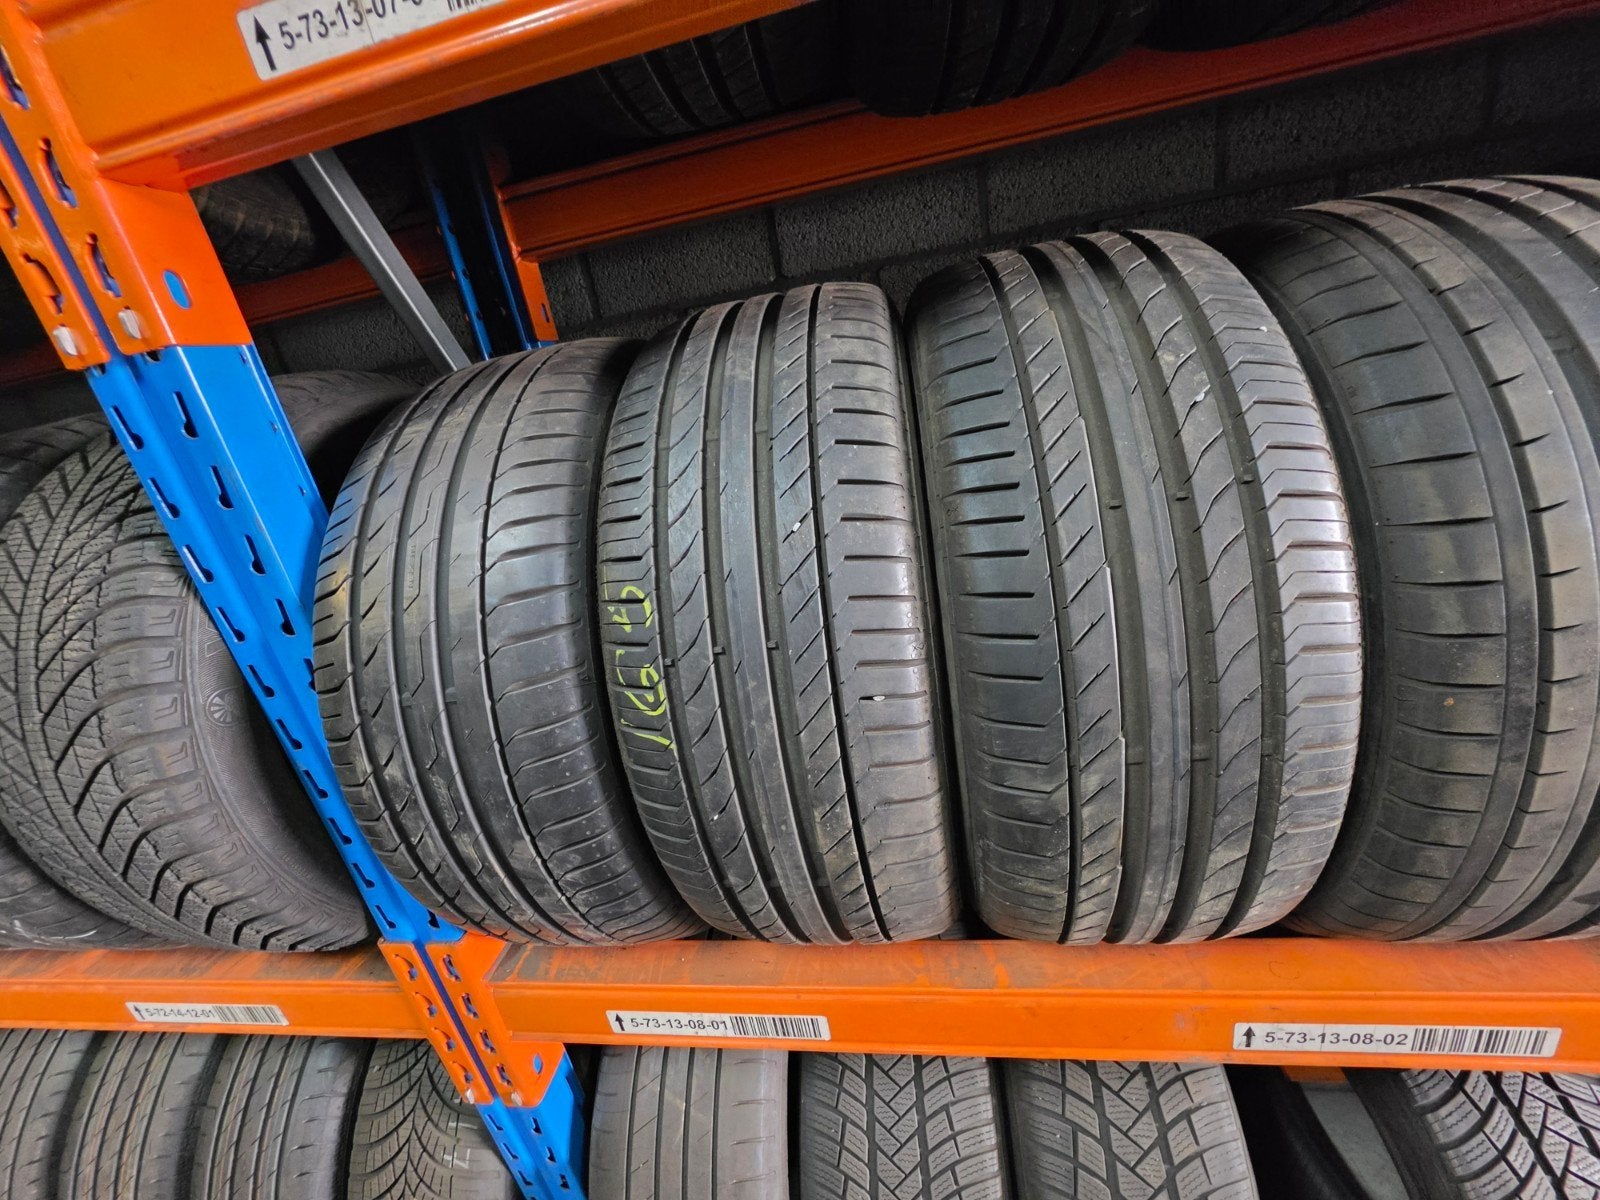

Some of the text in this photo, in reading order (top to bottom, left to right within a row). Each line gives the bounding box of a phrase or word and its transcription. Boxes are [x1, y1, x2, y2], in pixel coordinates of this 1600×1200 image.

[278, 0, 422, 50] 5-73-13-07
[145, 1007, 215, 1018] 5-72-14-12-01
[630, 1017, 728, 1031] 5-73-13-08-01
[1264, 1031, 1409, 1046] 5-73-13-08-02
